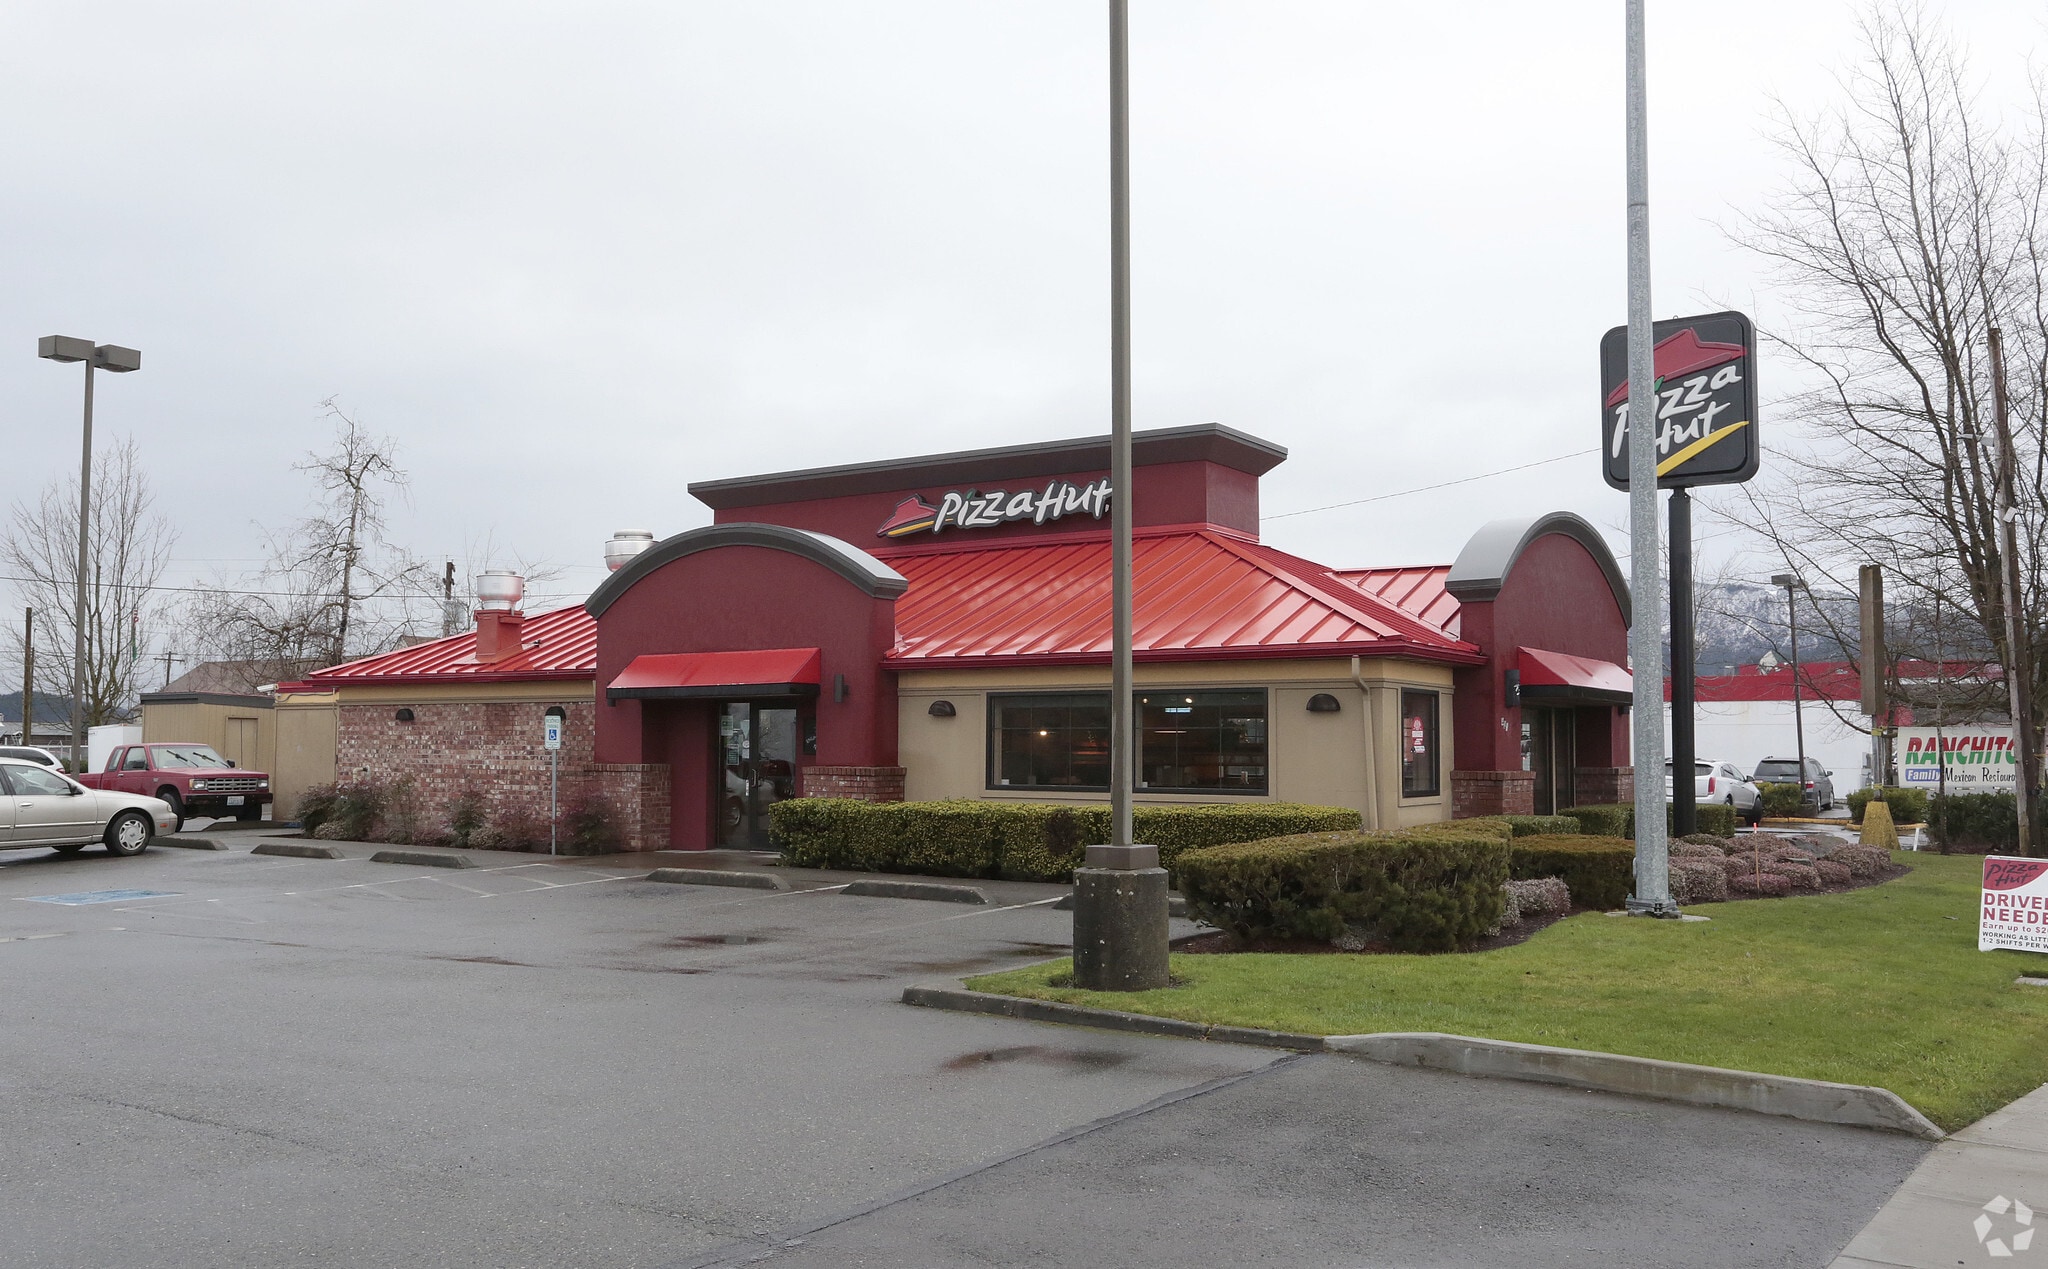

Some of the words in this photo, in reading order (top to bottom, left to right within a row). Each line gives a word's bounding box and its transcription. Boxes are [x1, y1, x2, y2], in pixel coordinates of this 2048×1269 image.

[934, 491, 1034, 532] Pizza
[1034, 480, 1112, 523] Hut
[1907, 769, 1941, 782] Family
[1945, 767, 1977, 782] Mexican
[1985, 860, 2040, 881] Pizza
[1995, 873, 2031, 886] Hut
[1982, 921, 2004, 930] Earn
[2035, 926, 2048, 934] $2
[1982, 931, 2017, 940] WORKING
[2030, 935, 2048, 943] LITT
[1995, 939, 2023, 947] SHIFTS
[2025, 941, 2041, 949] PER
